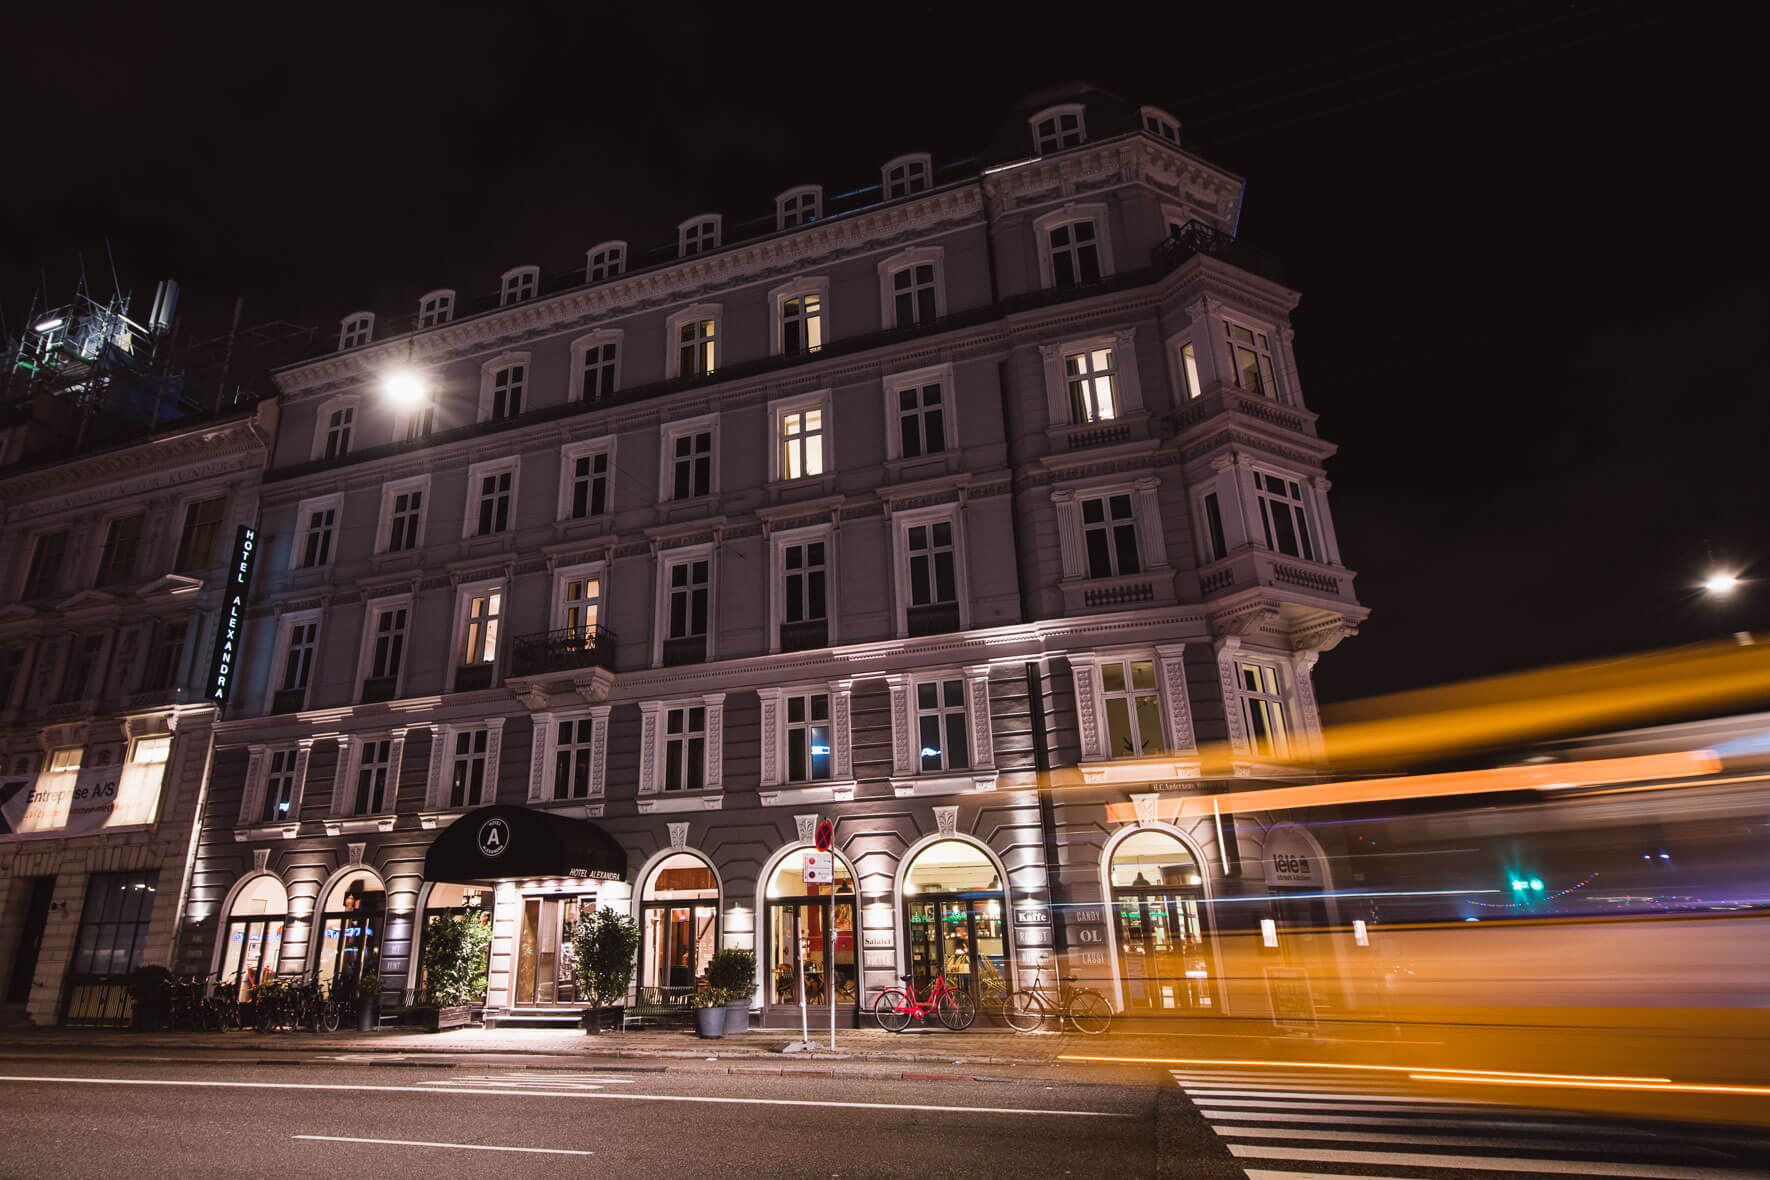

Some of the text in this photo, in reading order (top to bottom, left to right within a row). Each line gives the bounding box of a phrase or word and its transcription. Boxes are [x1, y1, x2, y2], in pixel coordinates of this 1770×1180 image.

[215, 530, 254, 699] HOTEL ALEXANDRA
[26, 782, 116, 804] Entrepse A/S
[487, 828, 500, 845] A
[569, 867, 621, 881] HOTEL ALEXANDRA
[1018, 911, 1047, 921] Kaffe
[1076, 911, 1101, 922] CANDY
[1082, 952, 1105, 965] LASSI
